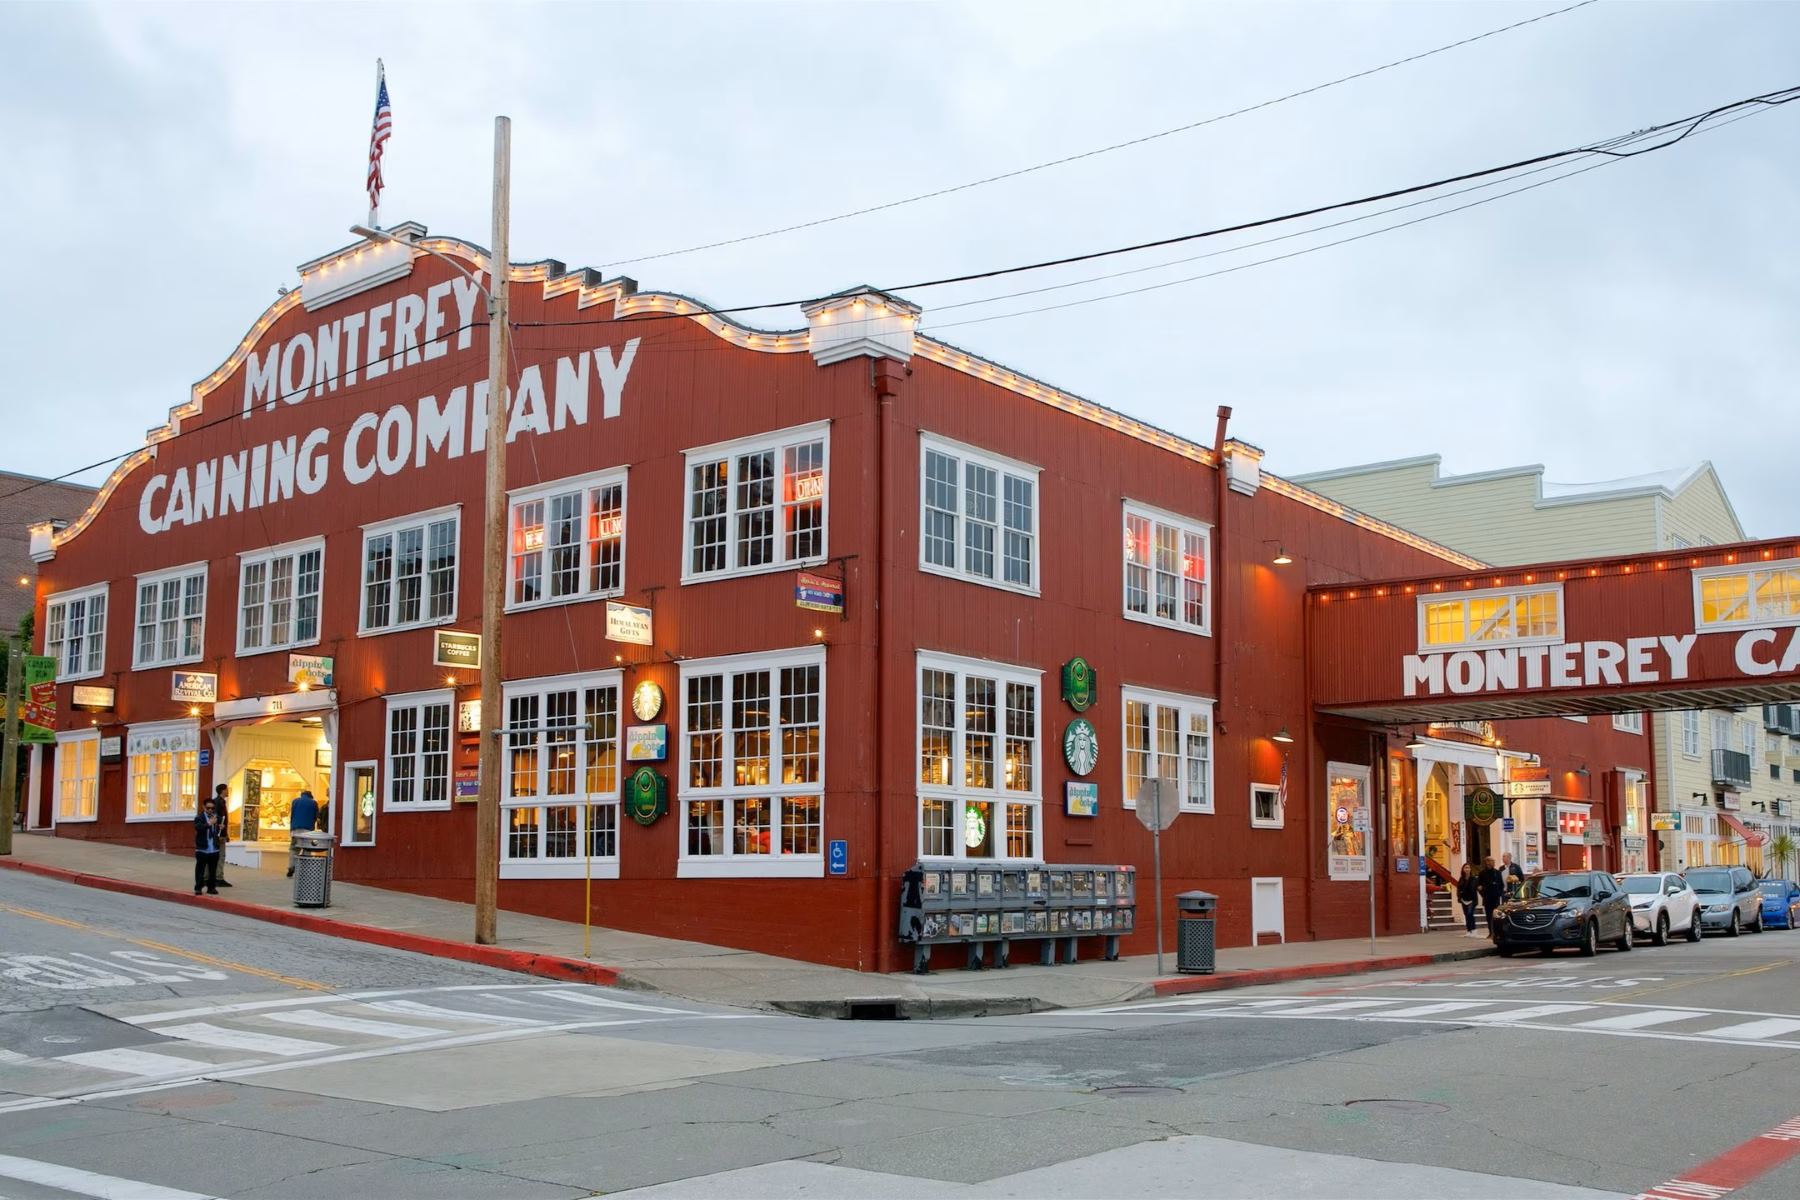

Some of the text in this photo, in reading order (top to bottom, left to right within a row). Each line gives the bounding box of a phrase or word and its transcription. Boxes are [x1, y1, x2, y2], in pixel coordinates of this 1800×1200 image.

[243, 270, 484, 419] MONTEREY
[139, 338, 641, 535] CANNING COMPANY
[440, 642, 477, 651] STARBUCKS
[1403, 634, 1697, 696] MONTEREY
